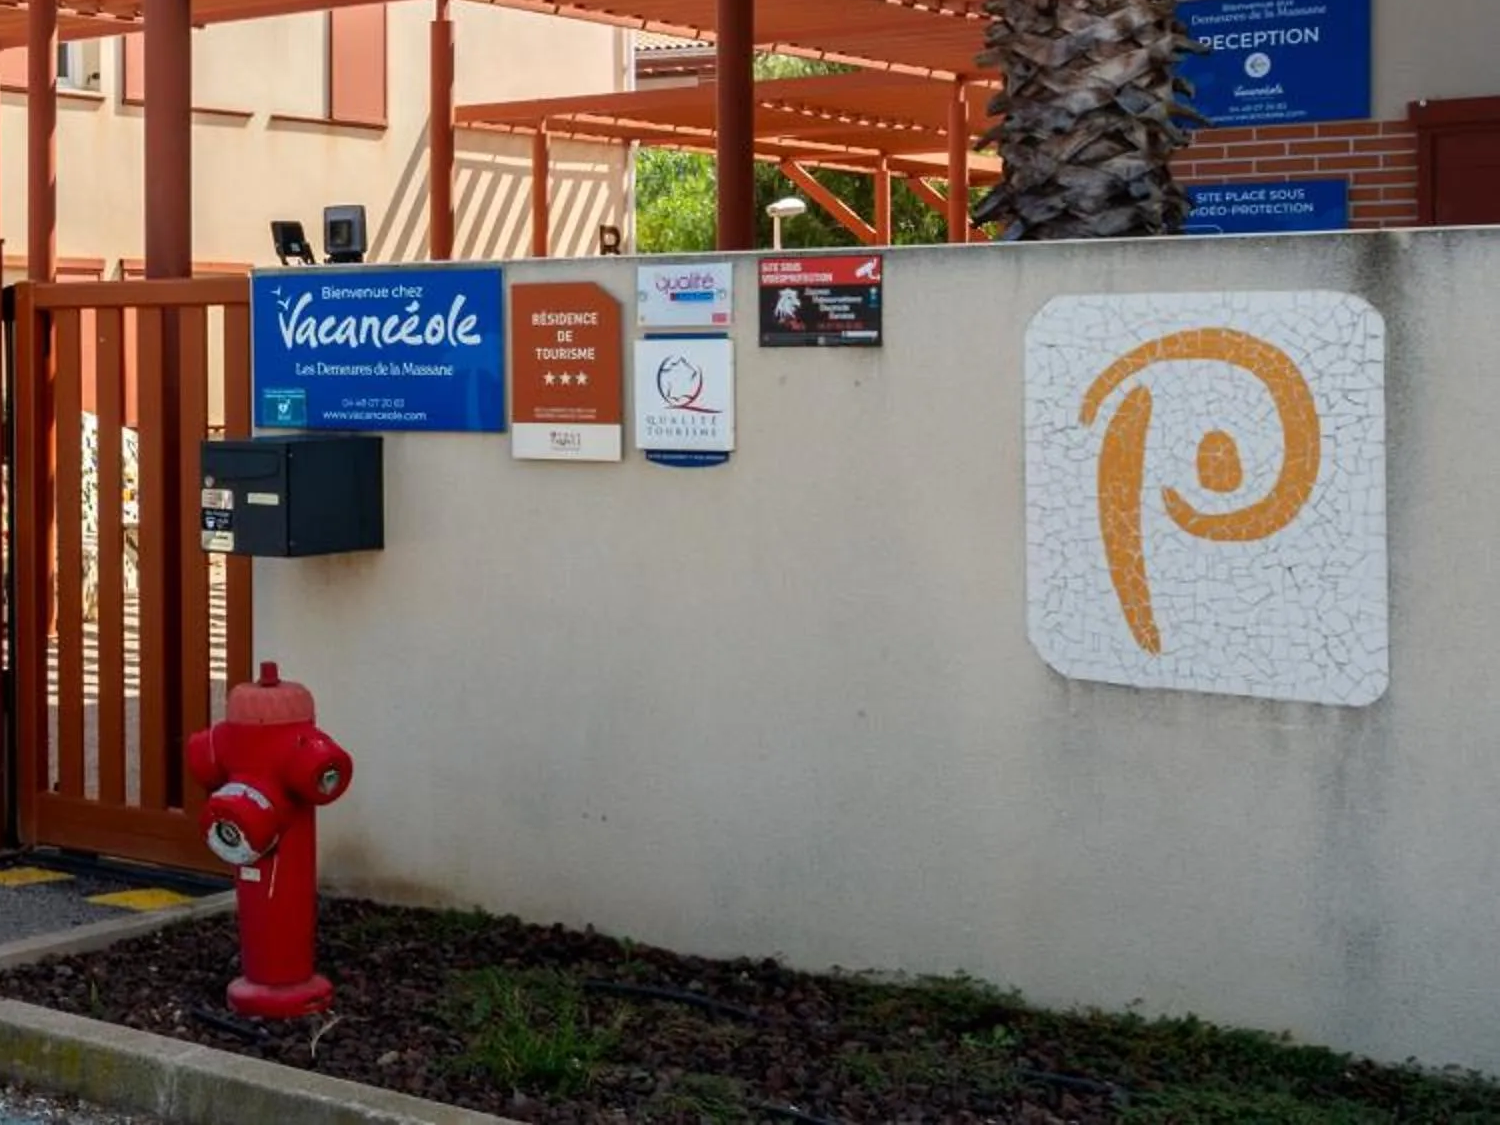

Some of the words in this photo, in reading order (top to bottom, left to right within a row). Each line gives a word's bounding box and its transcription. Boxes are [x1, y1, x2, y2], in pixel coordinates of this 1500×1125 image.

[1196, 191, 1221, 204] SITE
[1269, 187, 1305, 200] SOUS
[321, 285, 389, 300] Bienvenue
[391, 284, 423, 298] chez
[279, 292, 481, 350] Vacancéole
[531, 310, 598, 326] RÉSIDENCE
[557, 330, 573, 343] DE
[535, 347, 595, 361] TOURISME
[295, 362, 315, 376] Les
[317, 361, 372, 376] Demeures
[374, 360, 388, 376] de
[390, 361, 400, 375] la
[402, 361, 453, 376] Massane
